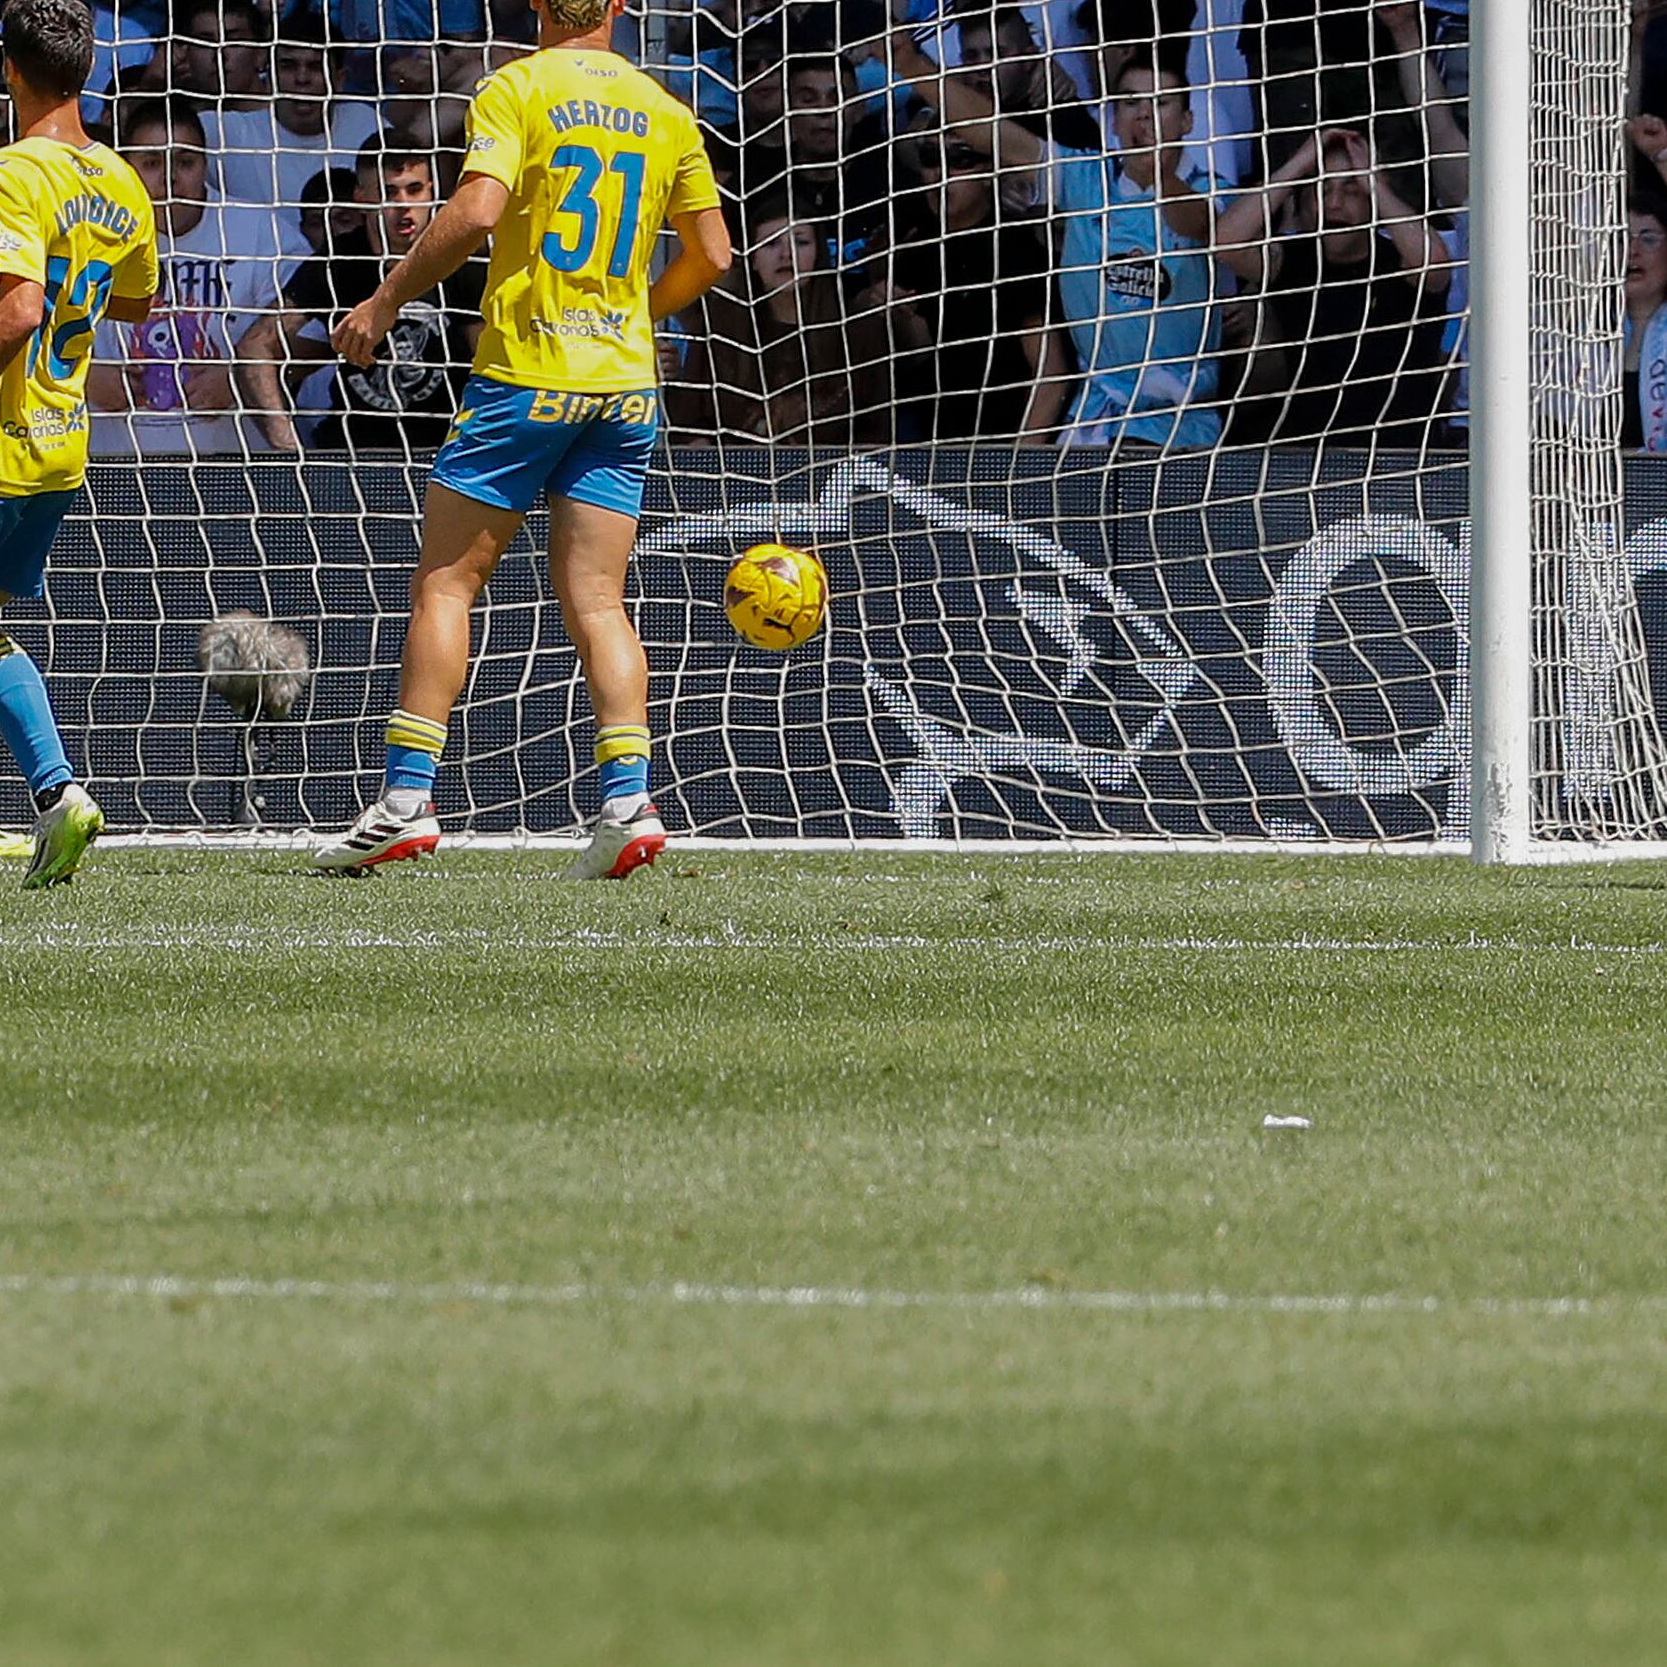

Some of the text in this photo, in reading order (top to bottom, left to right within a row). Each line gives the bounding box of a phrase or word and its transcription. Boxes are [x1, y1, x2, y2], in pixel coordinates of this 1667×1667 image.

[547, 99, 651, 138] HERZOG
[540, 144, 647, 279] 31
[527, 390, 658, 425] Binter
